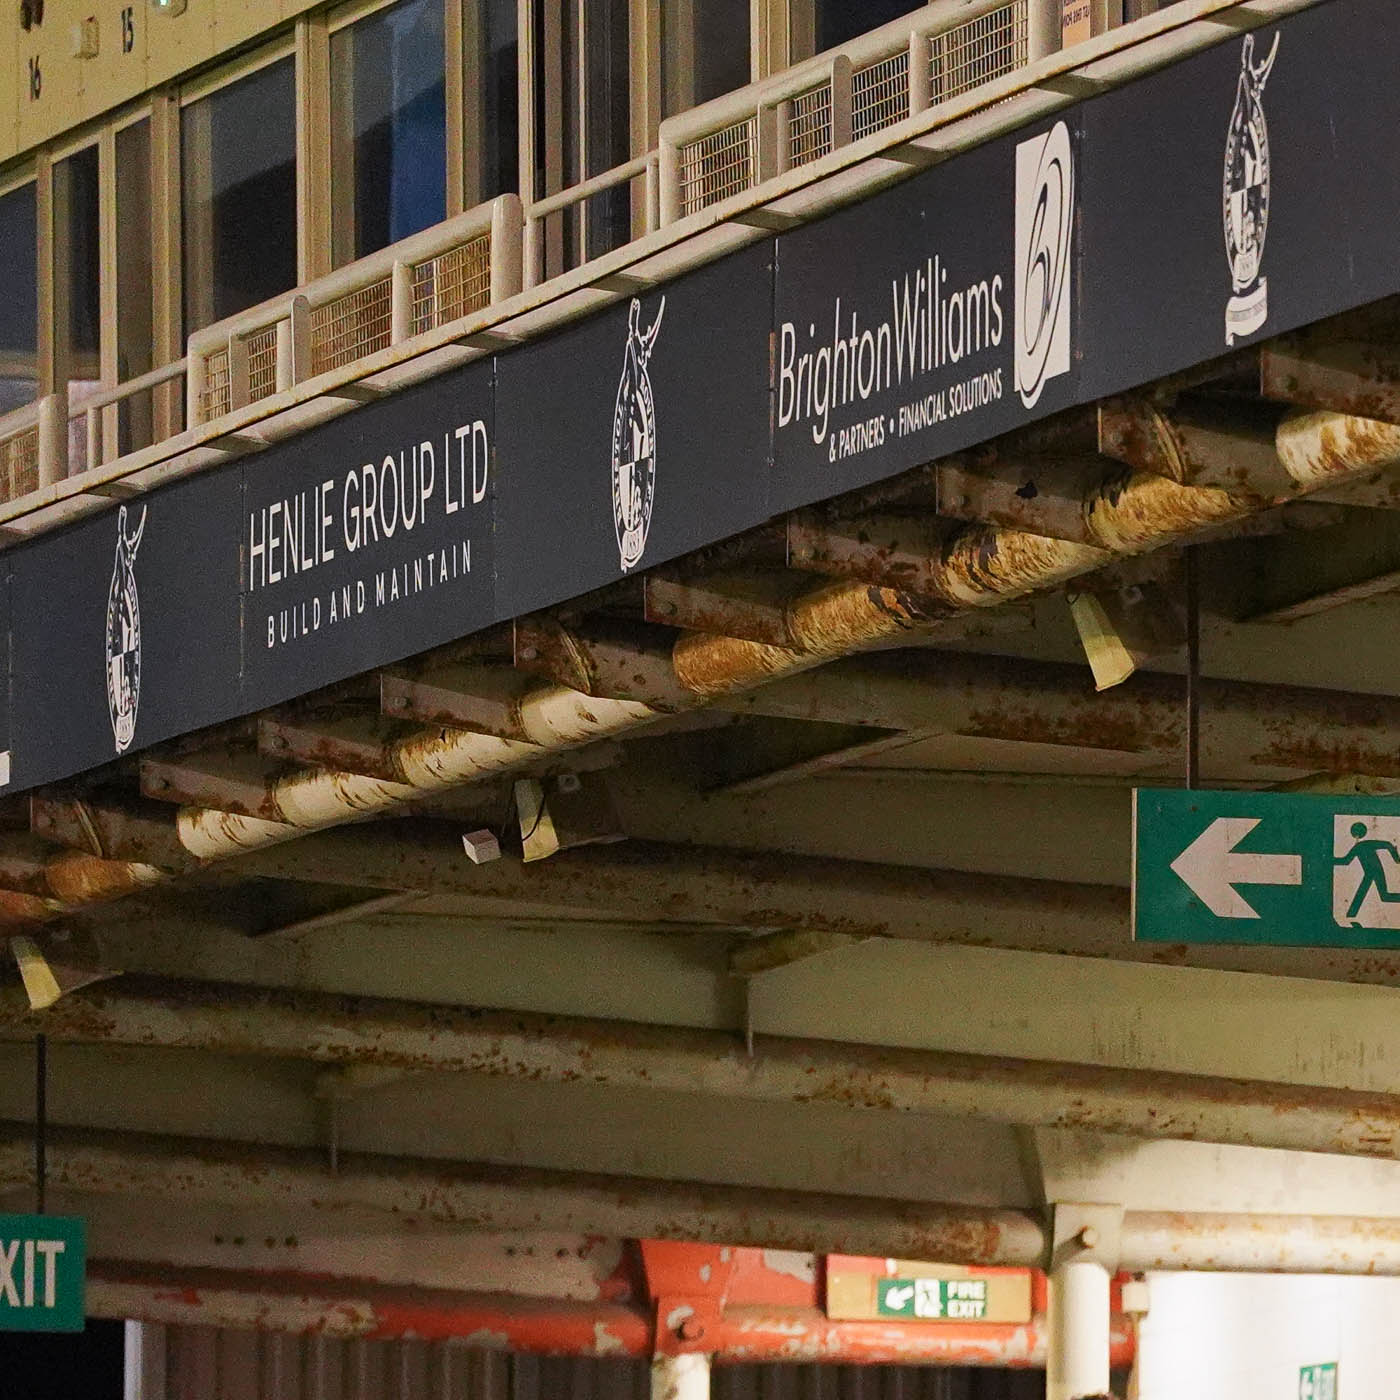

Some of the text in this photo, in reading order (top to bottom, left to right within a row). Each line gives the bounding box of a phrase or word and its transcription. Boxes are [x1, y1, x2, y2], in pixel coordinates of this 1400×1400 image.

[828, 368, 1003, 463] & PARTNERS FINANCIAL SOLUTIONS
[250, 479, 335, 591] HENLIE
[343, 441, 435, 552] GROUP
[445, 420, 489, 515] LTD
[267, 539, 471, 649] BUILD AND MAINTAIN
[946, 1280, 985, 1300] FIRE
[946, 1300, 985, 1319] EXIT
